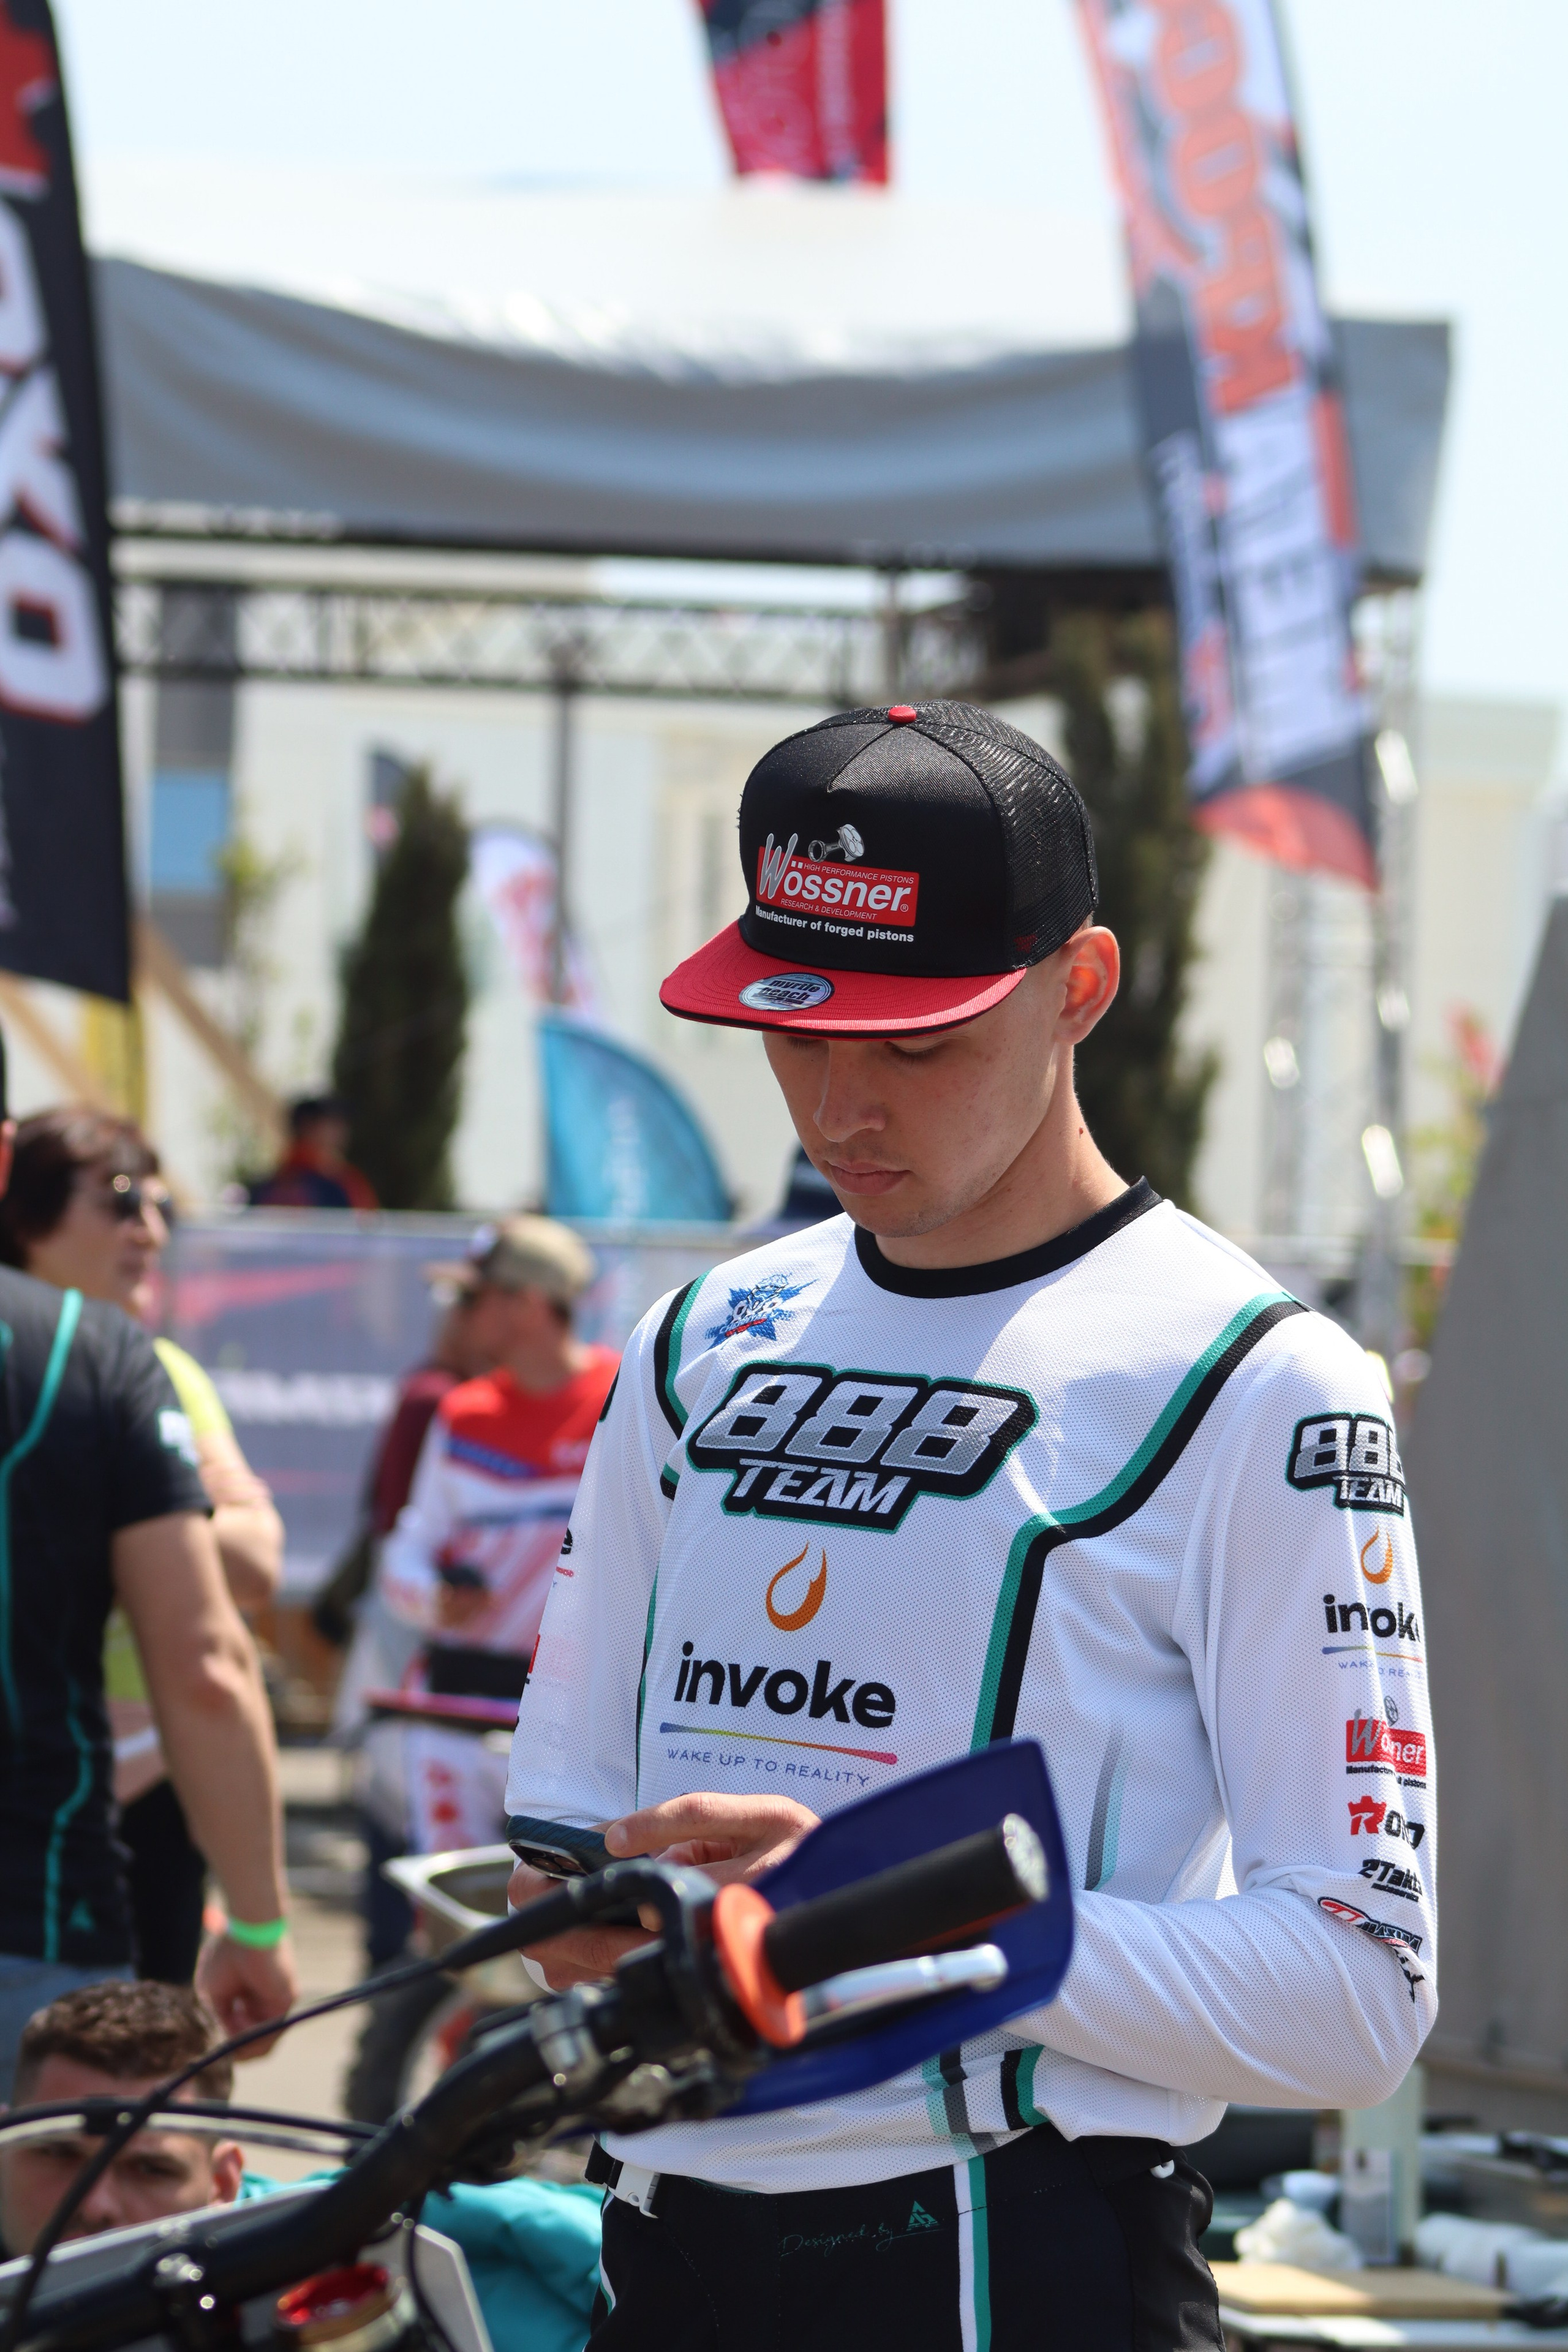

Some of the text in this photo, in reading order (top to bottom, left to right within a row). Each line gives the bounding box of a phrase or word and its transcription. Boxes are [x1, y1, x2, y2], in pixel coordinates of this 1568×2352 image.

[804, 863, 914, 884] HIGH PERFORMANCE PISTONS
[755, 905, 914, 943] Manufacturer of forged pistons
[780, 898, 814, 911] RESEARCH
[821, 906, 878, 919] DEVELOPMENT
[759, 987, 811, 1001] beach
[769, 979, 821, 993] myrtle
[695, 1372, 1019, 1474] 888
[732, 1458, 911, 1516] TEAM
[1332, 1475, 1403, 1509] TEAM
[1323, 1594, 1420, 1643] inok
[1338, 1660, 1374, 1670] WAK
[673, 1640, 897, 1728] invoke
[666, 1747, 870, 1787] WAKE UP TO REALITY
